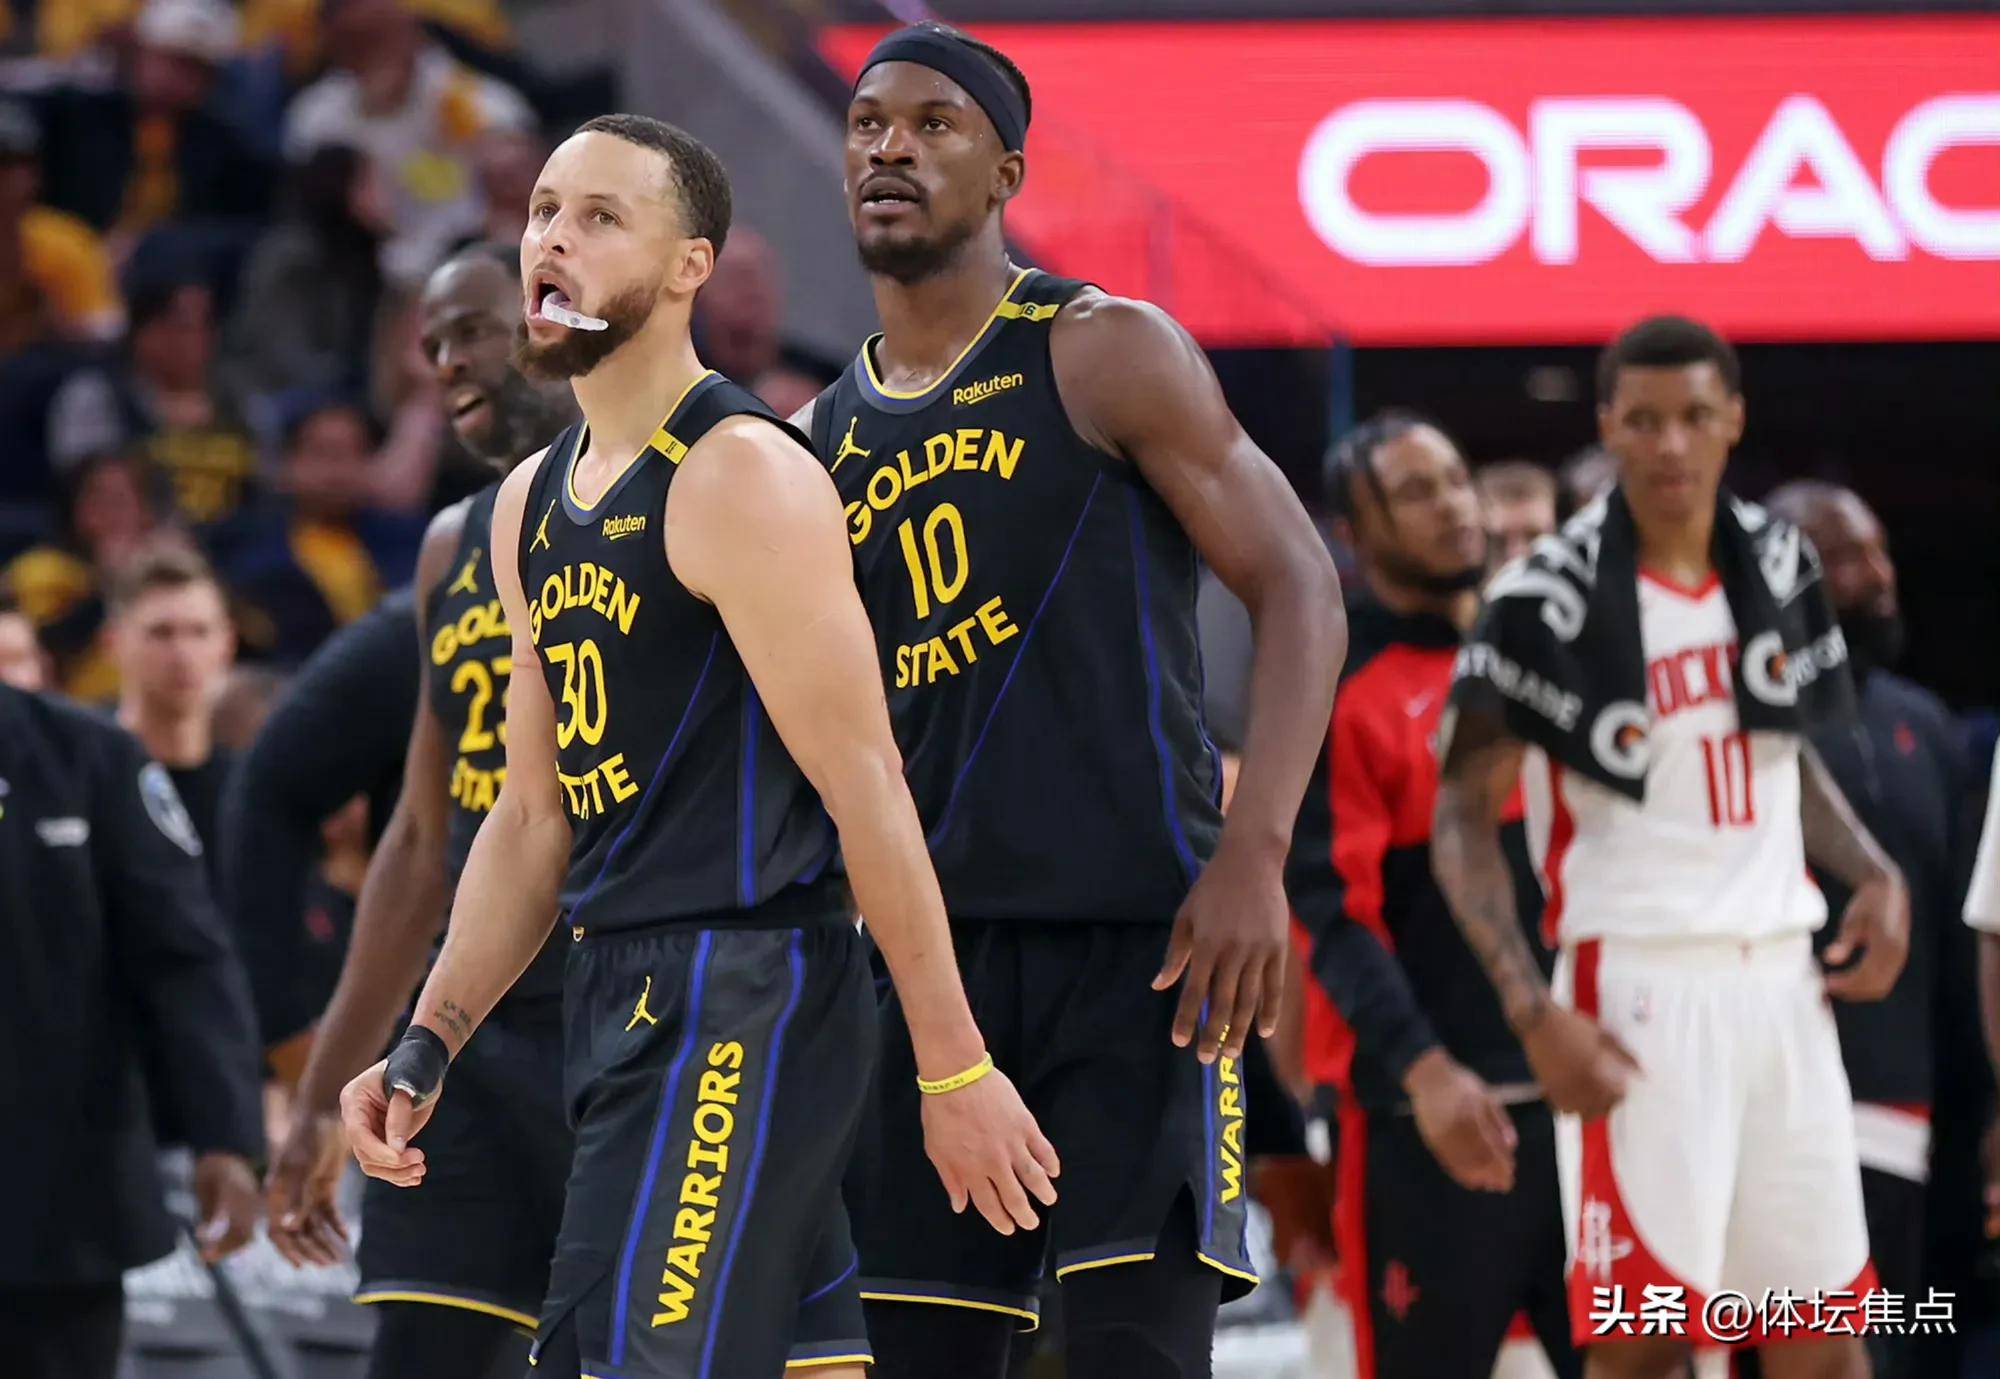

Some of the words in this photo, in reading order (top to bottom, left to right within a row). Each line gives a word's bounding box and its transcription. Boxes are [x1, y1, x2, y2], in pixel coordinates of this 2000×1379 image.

[953, 373, 1023, 405] Rakuten
[602, 514, 646, 540] Rakuten
[845, 429, 1026, 545] GOLDEN
[529, 562, 641, 646] GOLDEN
[898, 502, 969, 620] 10
[896, 595, 1020, 689] STATE
[544, 638, 607, 749] 30
[1701, 733, 1754, 828] 10
[651, 1041, 744, 1328] WARRIORS
